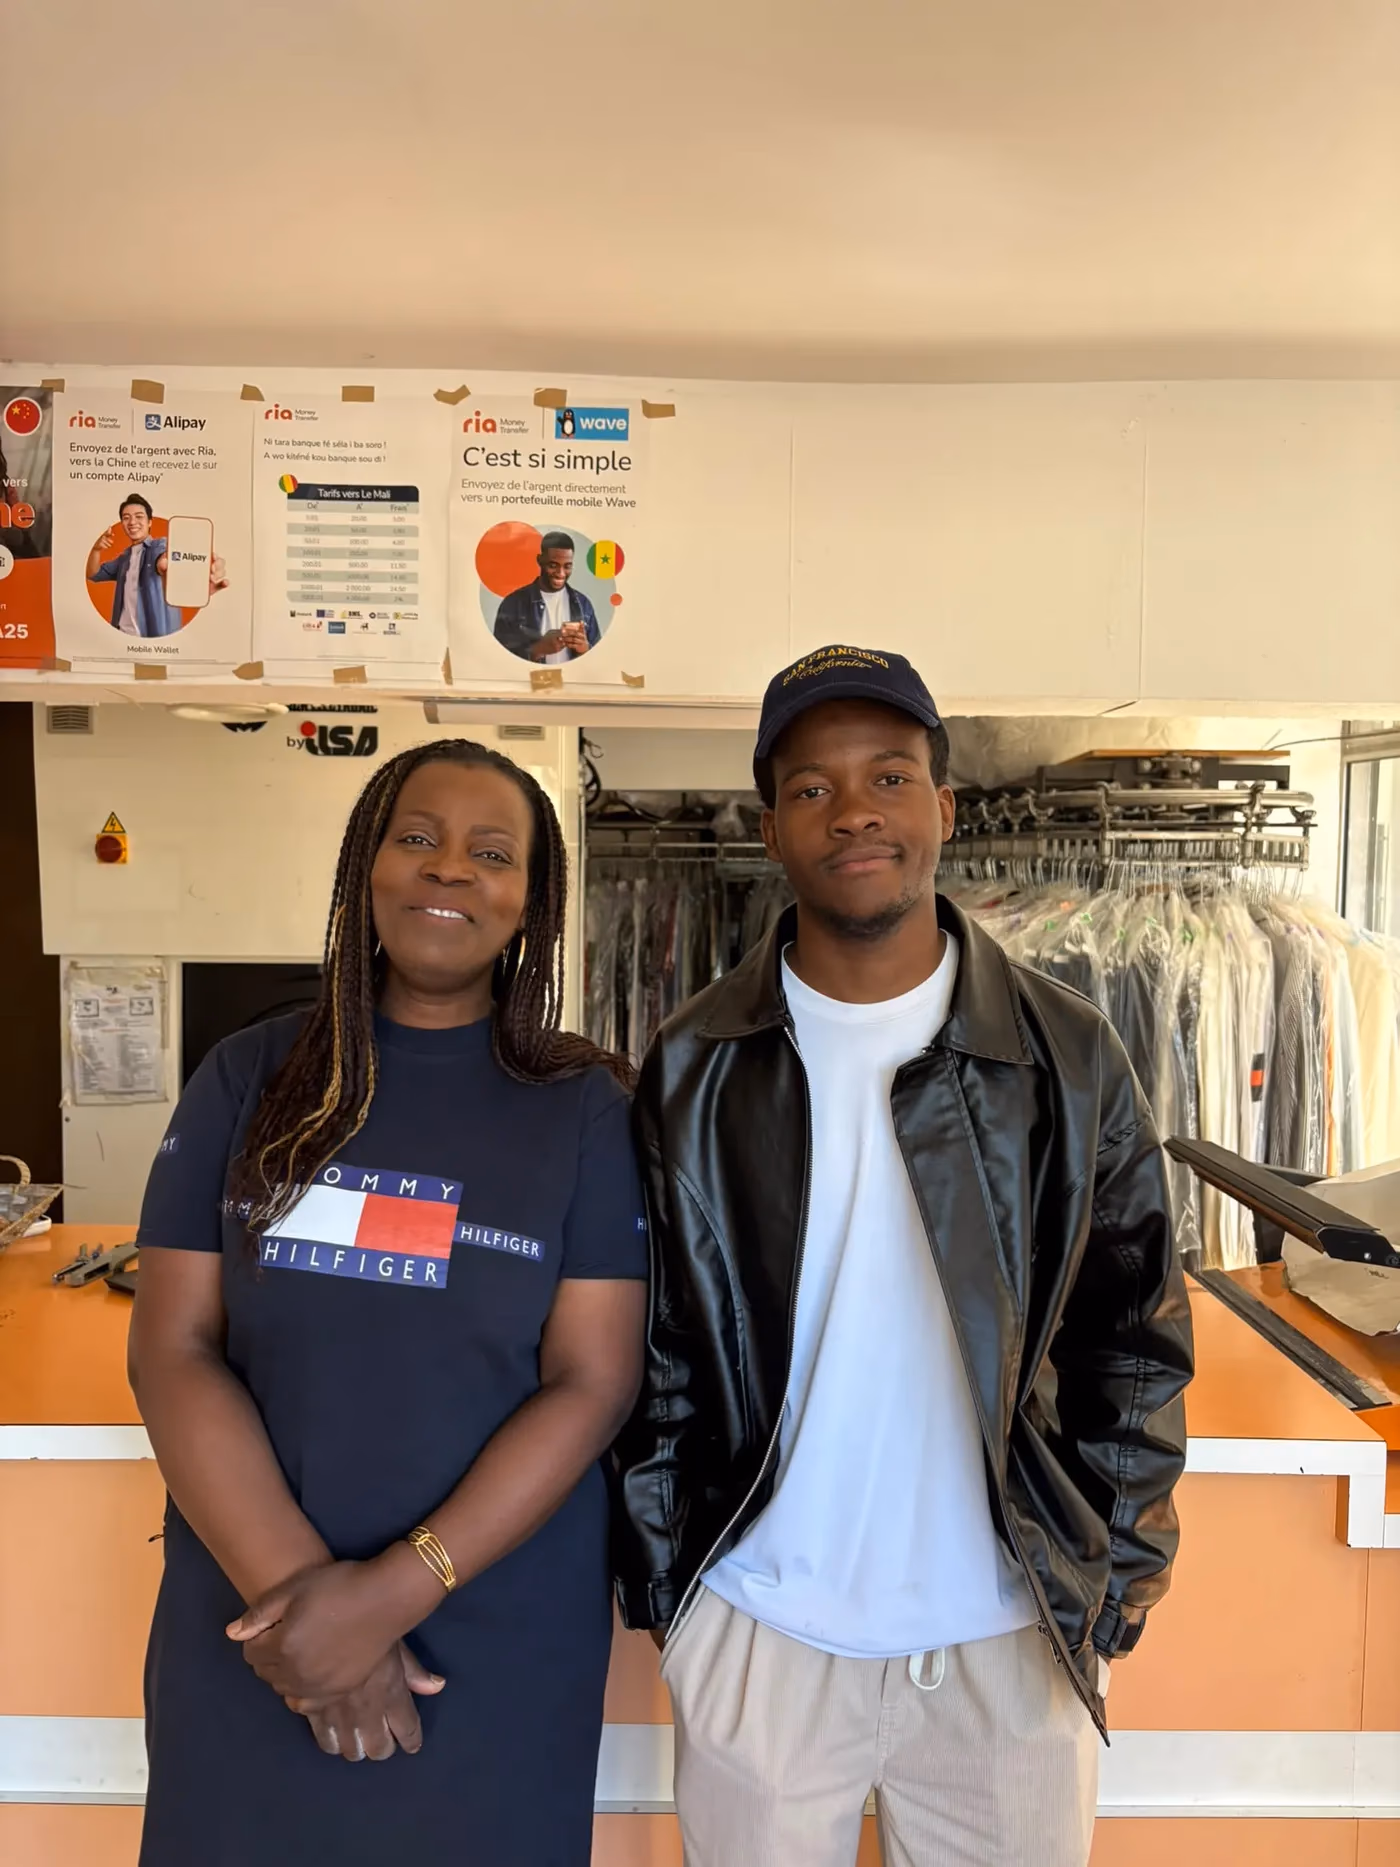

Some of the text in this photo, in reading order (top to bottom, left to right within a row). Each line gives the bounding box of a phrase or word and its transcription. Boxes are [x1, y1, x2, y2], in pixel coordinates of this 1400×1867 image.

[264, 404, 293, 420] ria
[69, 410, 97, 429] ria
[98, 416, 119, 424] Money
[163, 415, 207, 431] Alipay
[463, 410, 497, 433] ria
[500, 418, 526, 427] Money
[580, 417, 628, 431] wave
[69, 442, 217, 457] Envoyez de l'argent avec Ria,
[264, 438, 273, 446] Ni
[292, 439, 321, 448] banque
[323, 440, 331, 448] fé
[332, 440, 348, 448] séla
[69, 457, 218, 470] vers la Chine et recevez le sur
[312, 453, 326, 461] kou
[328, 454, 357, 463] banque
[463, 447, 632, 475] C'est si simple
[2, 478, 28, 488] vers
[69, 472, 83, 480] un
[85, 472, 125, 483] compte
[461, 478, 626, 494] Envoyez de l'argent directement
[317, 488, 391, 499] Tarifs vers Le Mali
[461, 494, 637, 508] vers un portefeuille mobile Wave
[182, 552, 207, 562] Alipay
[127, 644, 180, 654] Mobile Wallet
[782, 647, 889, 686] SAN FRANCISCO
[286, 736, 306, 750] by
[323, 1166, 455, 1200] OMMY
[460, 1226, 540, 1257] HILFIGER
[264, 1241, 438, 1283] HILFIGER
